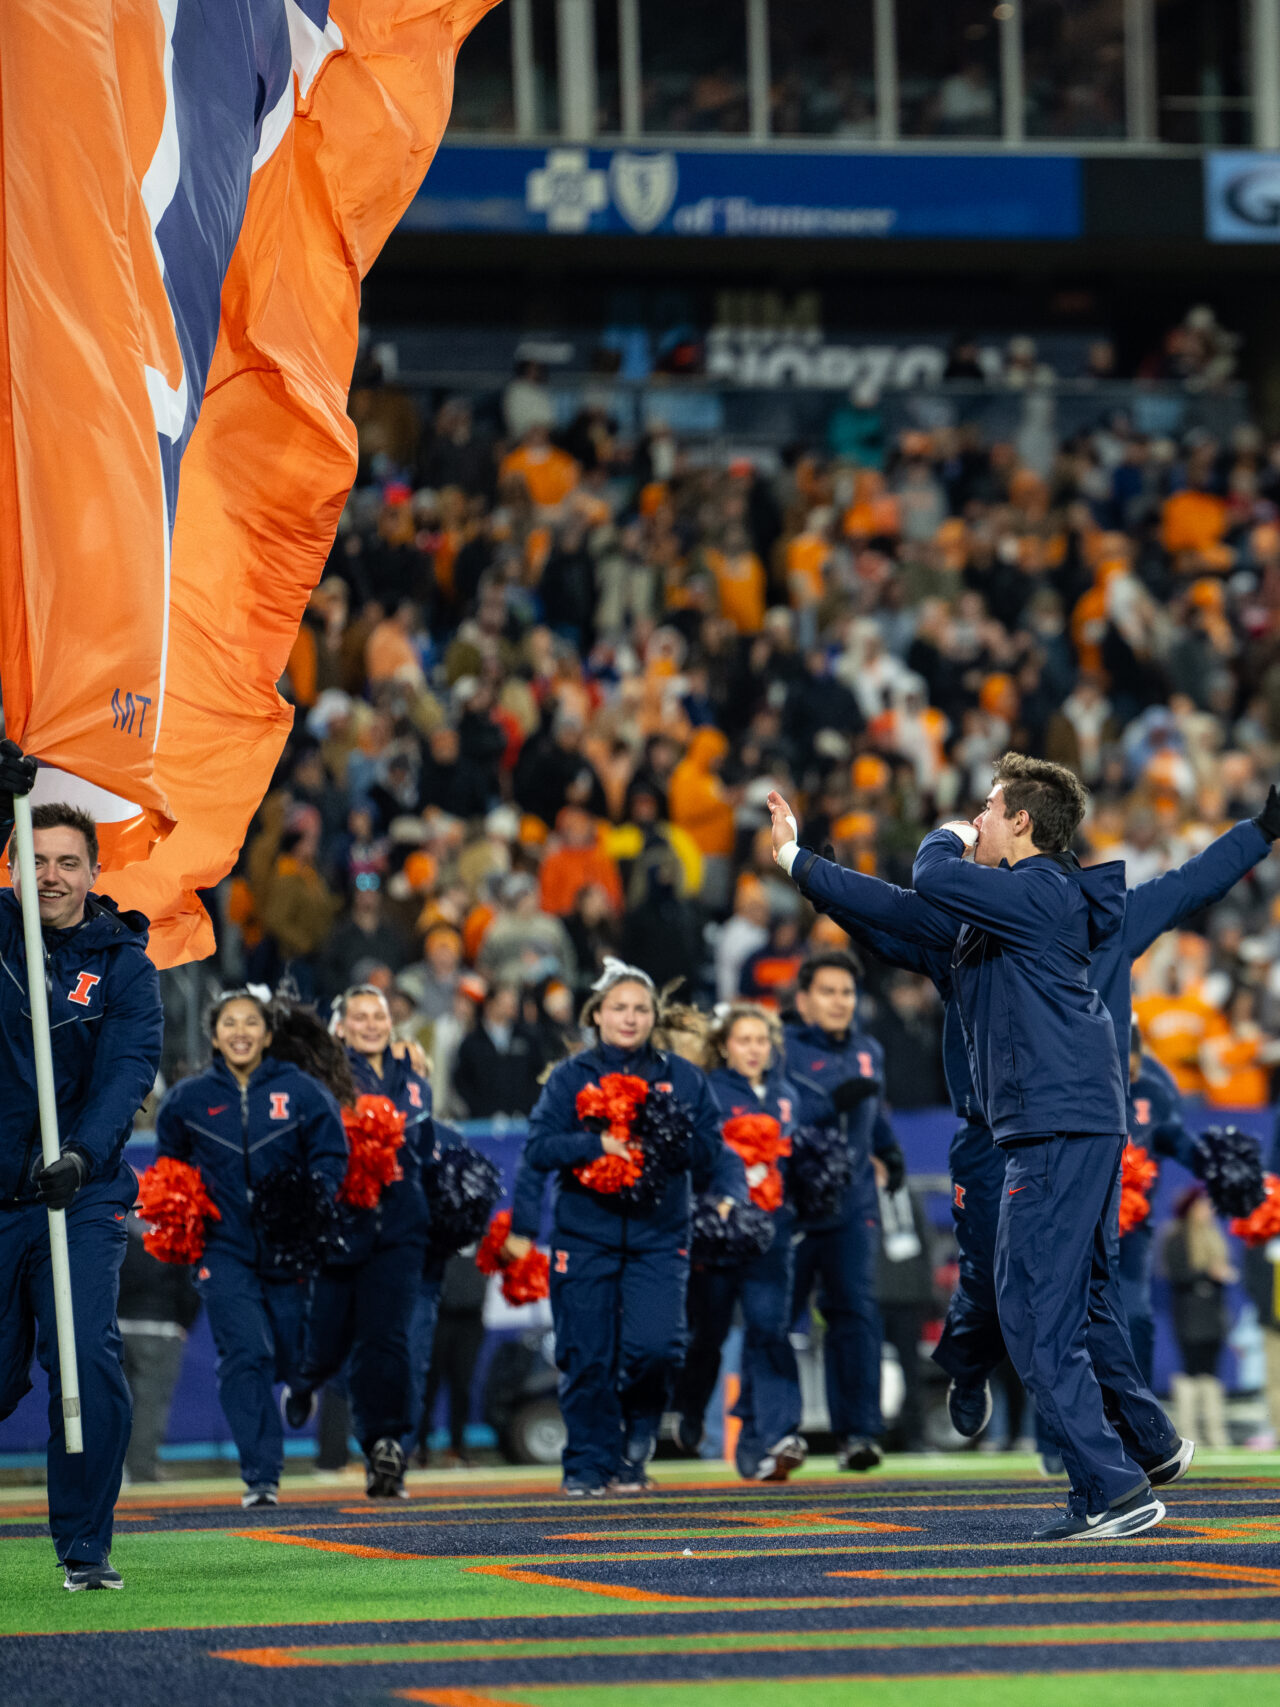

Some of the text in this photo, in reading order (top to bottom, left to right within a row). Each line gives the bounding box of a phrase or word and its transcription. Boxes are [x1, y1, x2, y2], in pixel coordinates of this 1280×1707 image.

[111, 688, 152, 738] MT
[67, 971, 101, 1007] I
[269, 1092, 290, 1119] I
